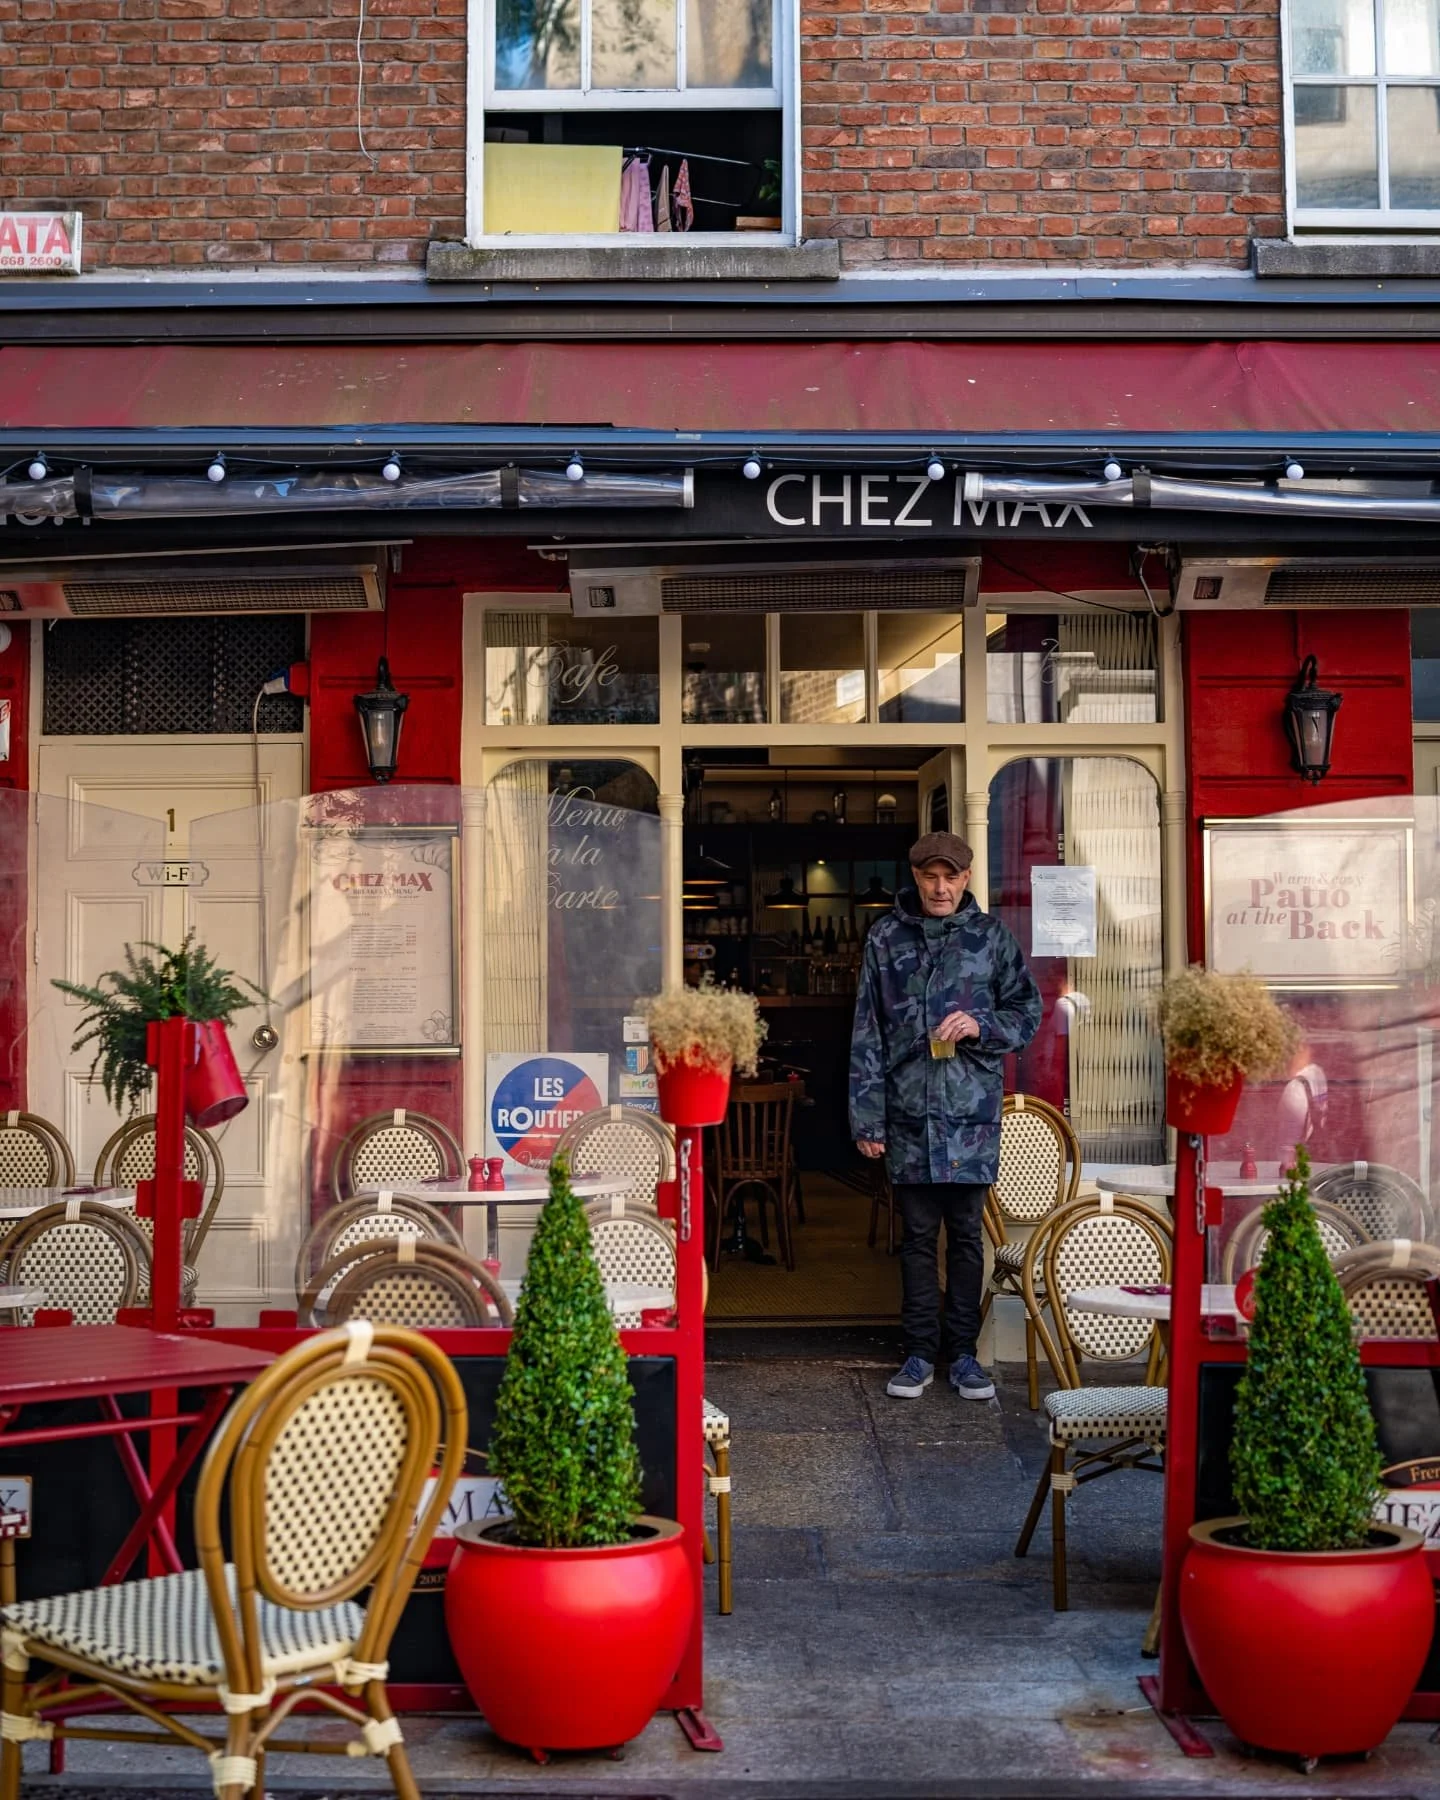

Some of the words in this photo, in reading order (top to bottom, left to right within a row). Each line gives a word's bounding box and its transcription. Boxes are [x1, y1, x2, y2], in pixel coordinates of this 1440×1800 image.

[30, 256, 62, 266] 2600
[766, 474, 933, 527] CHEZ
[166, 808, 176, 832] 1
[570, 834, 605, 866] la
[146, 866, 196, 881] Wi-Fi
[332, 873, 385, 892] CHEZ
[391, 872, 433, 892] MAX
[1248, 878, 1351, 909] Patio
[1226, 909, 1248, 925] at
[1254, 906, 1288, 926] the
[1288, 909, 1385, 940] Back
[534, 1077, 565, 1101] LES
